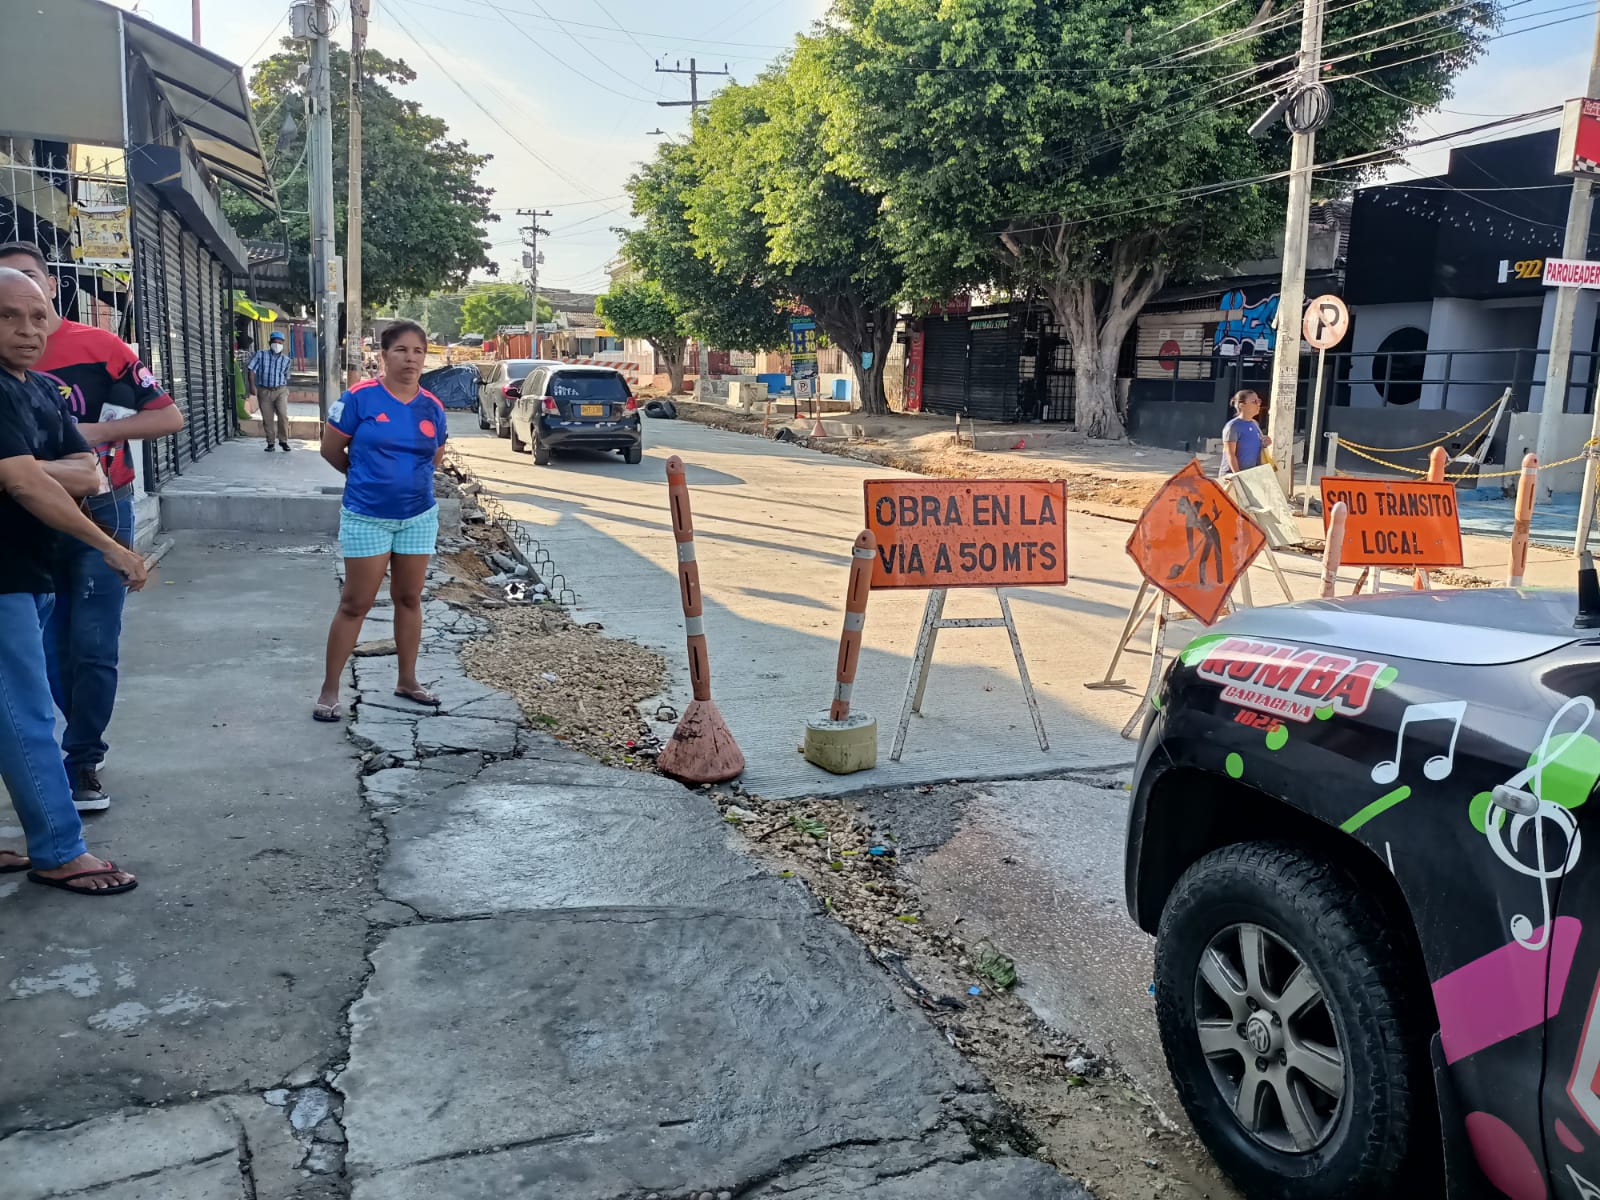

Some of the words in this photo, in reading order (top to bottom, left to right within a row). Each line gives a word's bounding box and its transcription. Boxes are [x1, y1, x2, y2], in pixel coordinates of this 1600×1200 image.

[791, 342, 796, 352] 2
[805, 341, 816, 351] 90
[805, 330, 815, 340] 50
[875, 496, 962, 526] OBRA
[972, 495, 1010, 526] EN
[1020, 495, 1056, 526] LA
[1374, 492, 1453, 517] TRANSITO
[1362, 530, 1424, 555] LOCAL
[878, 539, 926, 575] VIA
[934, 543, 952, 573] A
[959, 542, 997, 572] 50
[1003, 541, 1057, 572] MTS
[1201, 638, 1381, 709] RUMBA
[1225, 686, 1312, 718] CARTAGENA
